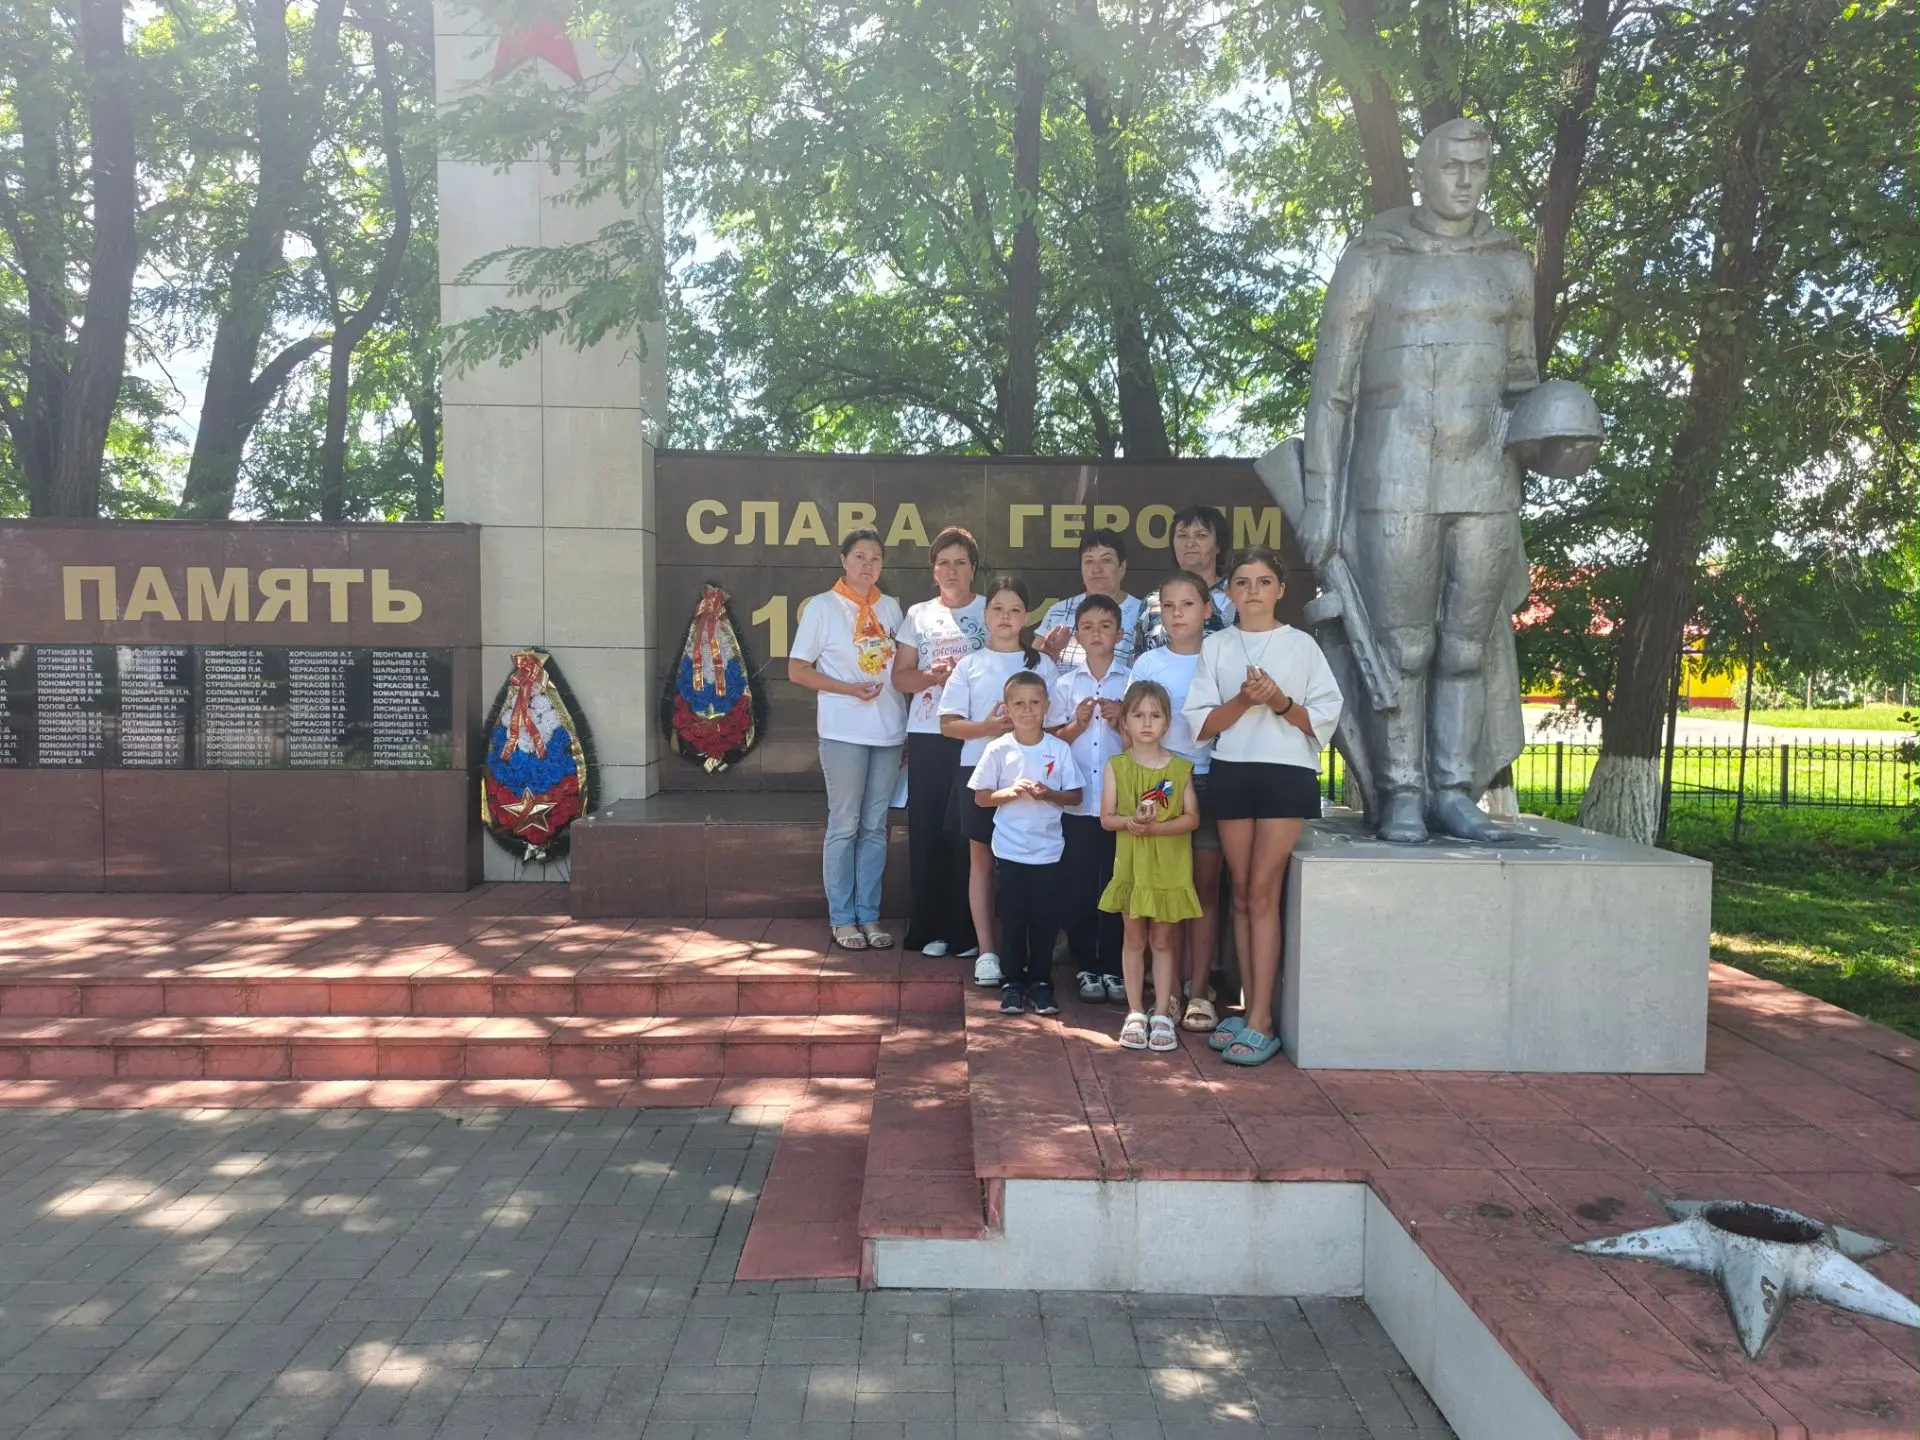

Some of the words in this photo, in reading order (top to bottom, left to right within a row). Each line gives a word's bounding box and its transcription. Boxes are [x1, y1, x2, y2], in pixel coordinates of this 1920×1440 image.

[685, 499, 931, 548] СЛАВА
[1009, 503, 1282, 551] ГЕРОМ
[62, 565, 424, 623] ПАМЯТЬ
